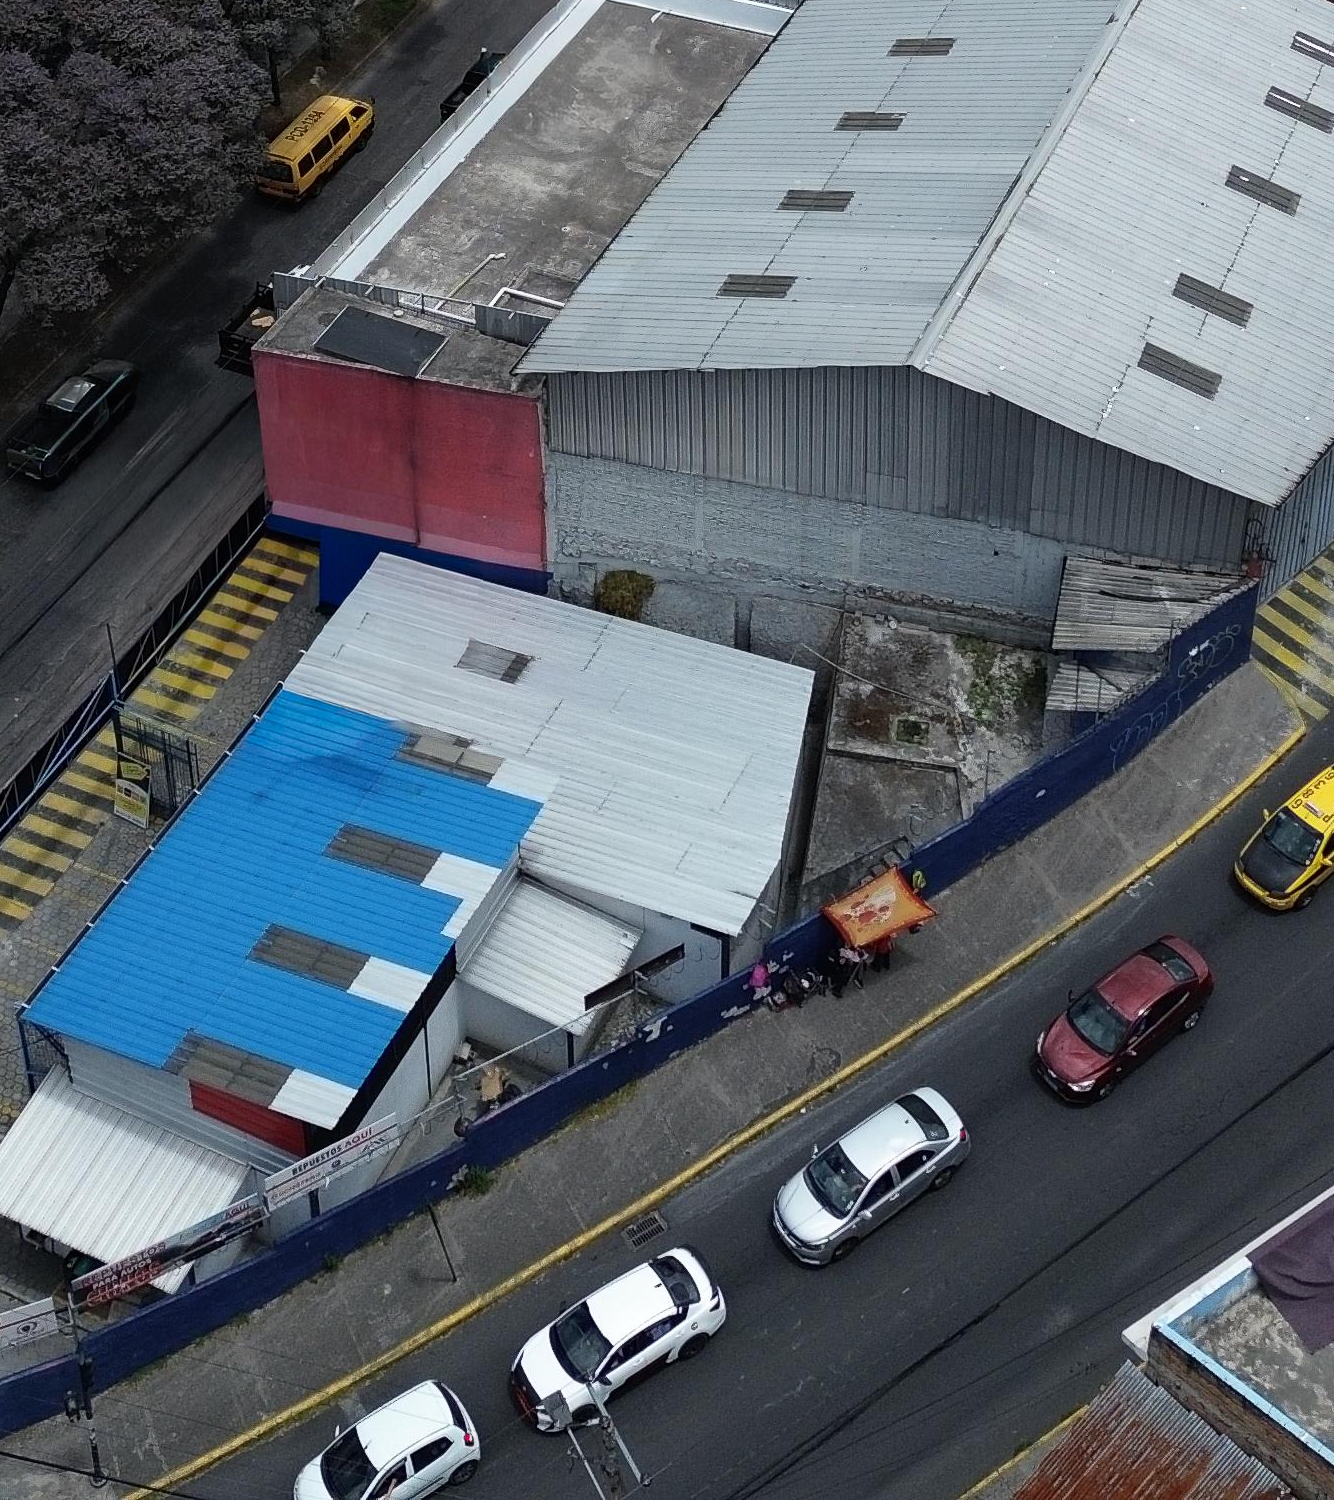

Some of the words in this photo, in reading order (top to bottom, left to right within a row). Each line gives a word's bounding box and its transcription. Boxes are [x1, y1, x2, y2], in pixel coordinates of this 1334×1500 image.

[292, 1144, 342, 1176] REPUESTOS
[92, 1275, 118, 1291] PARA
[120, 1258, 152, 1277] AUTOS
